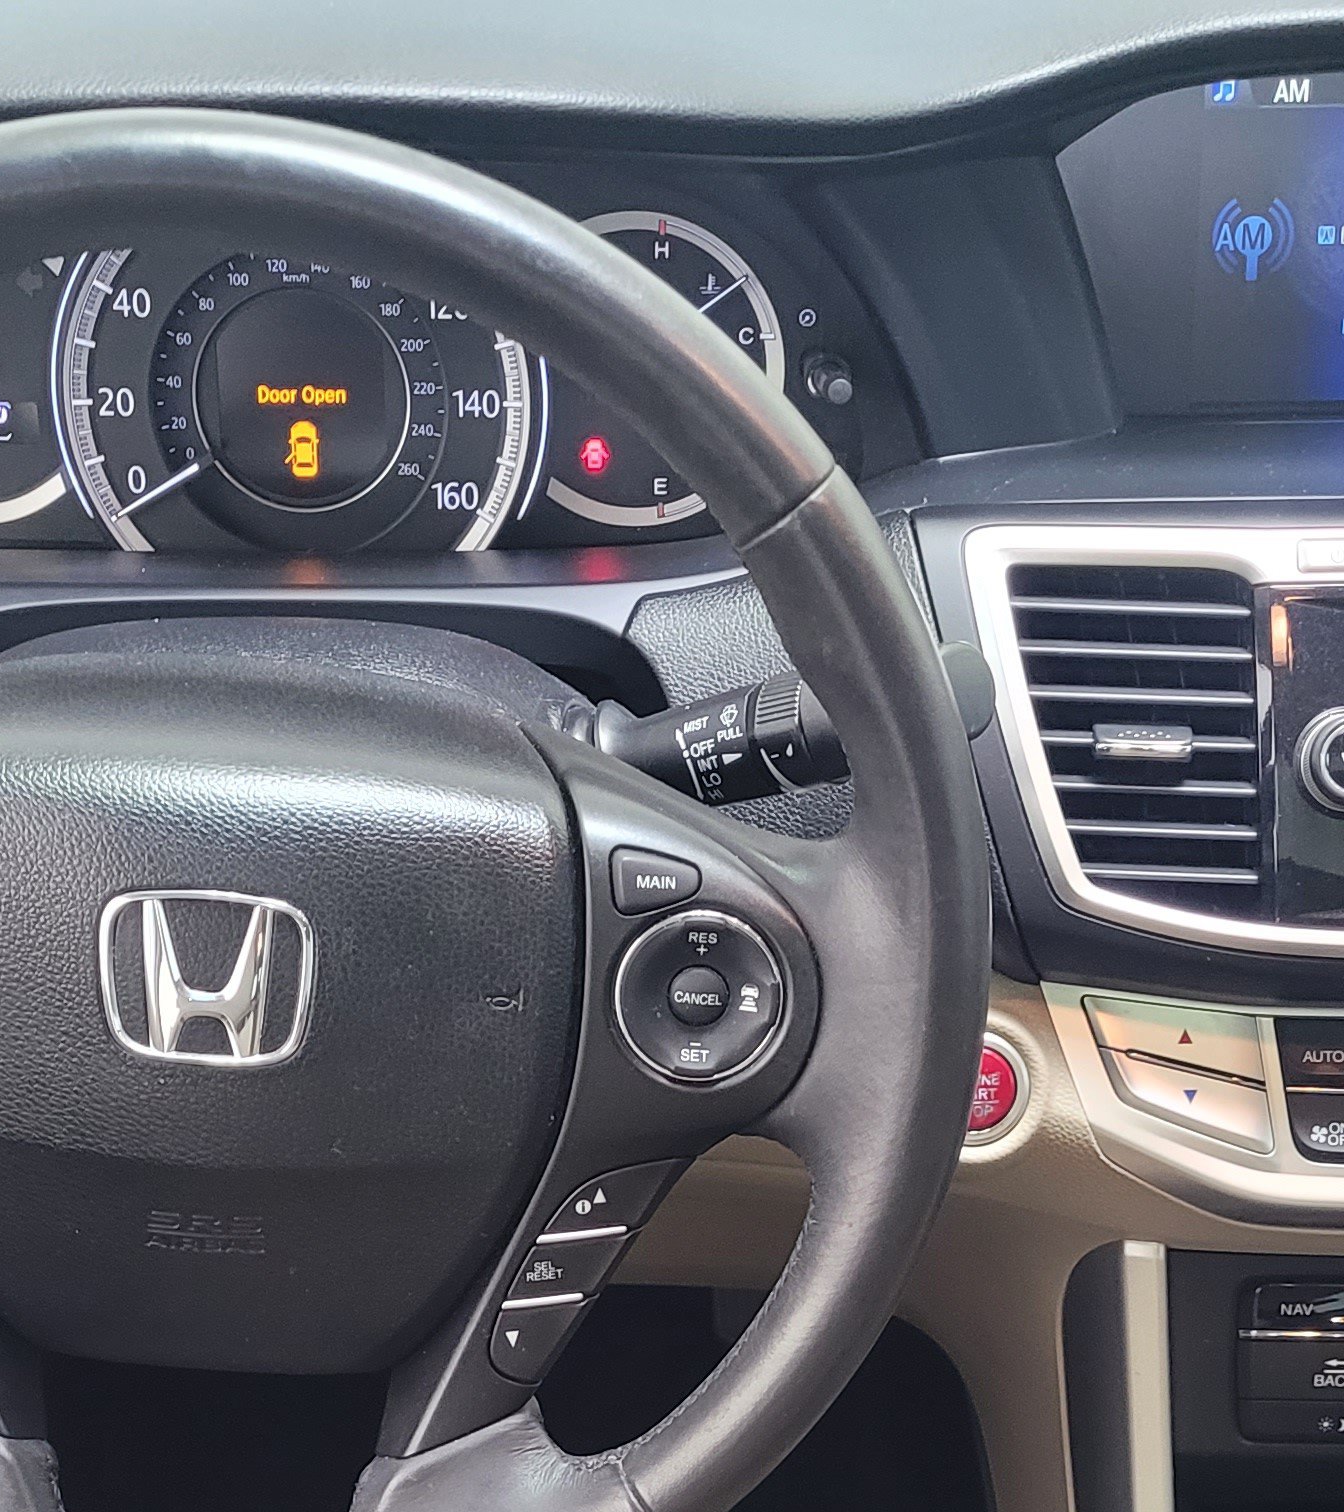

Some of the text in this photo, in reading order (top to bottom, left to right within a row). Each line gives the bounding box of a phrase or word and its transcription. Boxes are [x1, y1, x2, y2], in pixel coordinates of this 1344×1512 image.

[1273, 78, 1310, 103] AM
[654, 241, 670, 259] H
[265, 259, 288, 273] 120
[227, 272, 249, 287] 100
[282, 273, 310, 283] km/h
[350, 276, 371, 290] 160
[112, 288, 152, 318] 40
[198, 297, 215, 312] 80
[379, 303, 401, 317] 180
[176, 332, 192, 346] 60
[738, 327, 754, 345] C
[400, 339, 424, 352] 200
[165, 375, 182, 389] 40
[413, 382, 435, 395] 220
[98, 387, 135, 418] 20
[257, 384, 347, 406] Door Open
[452, 390, 500, 418] 140
[171, 417, 187, 430] 20
[411, 424, 434, 437] 240
[186, 447, 195, 460] 0
[398, 463, 420, 476] 260
[127, 465, 147, 495] 0
[654, 477, 668, 495] E
[431, 482, 479, 510] 160
[683, 716, 709, 734] MIST
[717, 727, 743, 744] PULL
[690, 739, 715, 758] OFF
[697, 755, 720, 772] INT
[702, 772, 722, 788] LO
[708, 789, 725, 801] HI
[636, 875, 676, 890] MAIN
[688, 932, 718, 944] RES
[674, 991, 722, 1006] CANCEL
[681, 1049, 710, 1062] SET
[1302, 1050, 1344, 1063] AUTO
[534, 1261, 555, 1272] SEL
[526, 1268, 564, 1283] RESET
[1280, 1304, 1314, 1316] NAV
